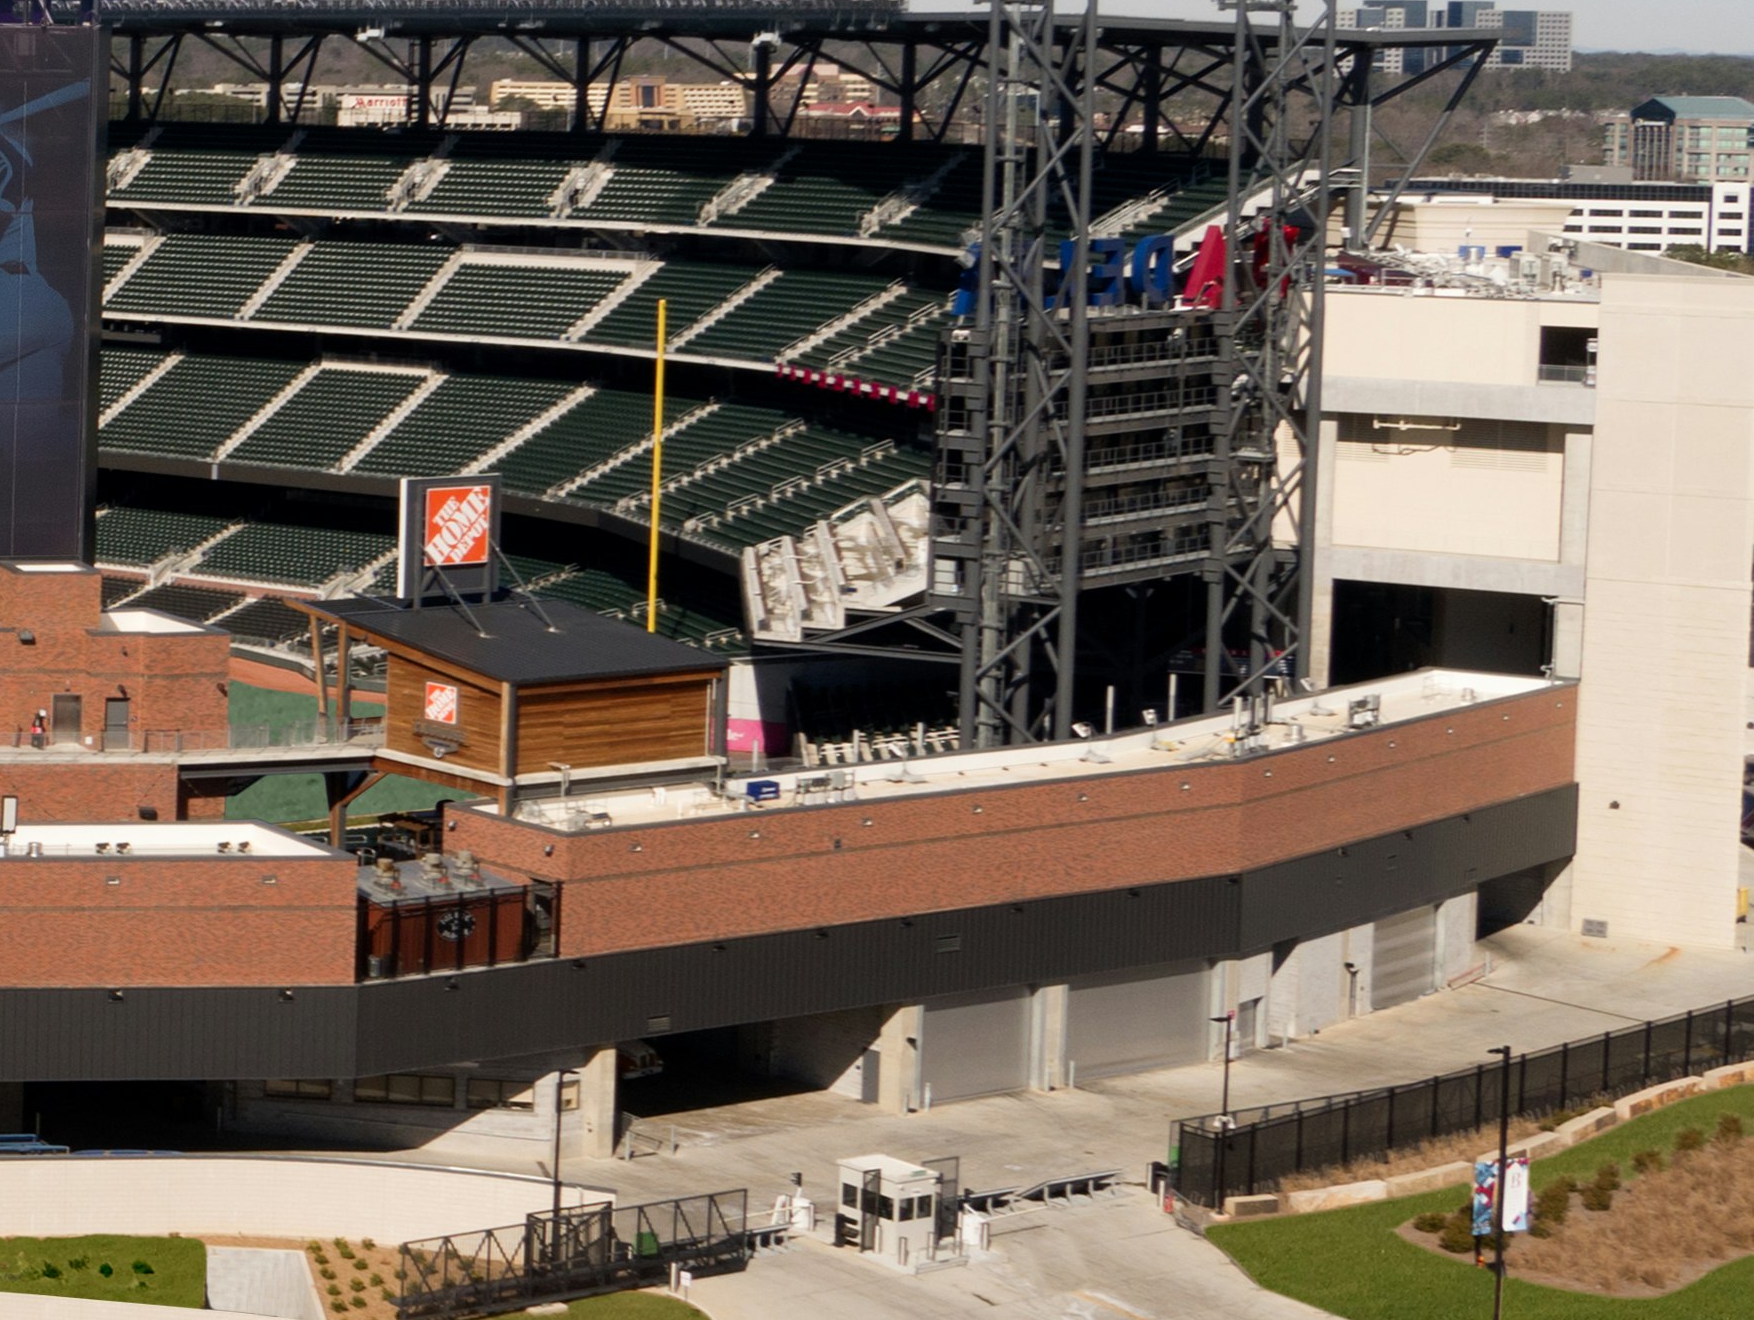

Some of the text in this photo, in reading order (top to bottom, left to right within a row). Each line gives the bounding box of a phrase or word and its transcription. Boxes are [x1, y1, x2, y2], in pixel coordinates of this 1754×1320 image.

[425, 487, 490, 565] HOME
[433, 496, 461, 528] THE
[449, 514, 488, 563] DEPOT
